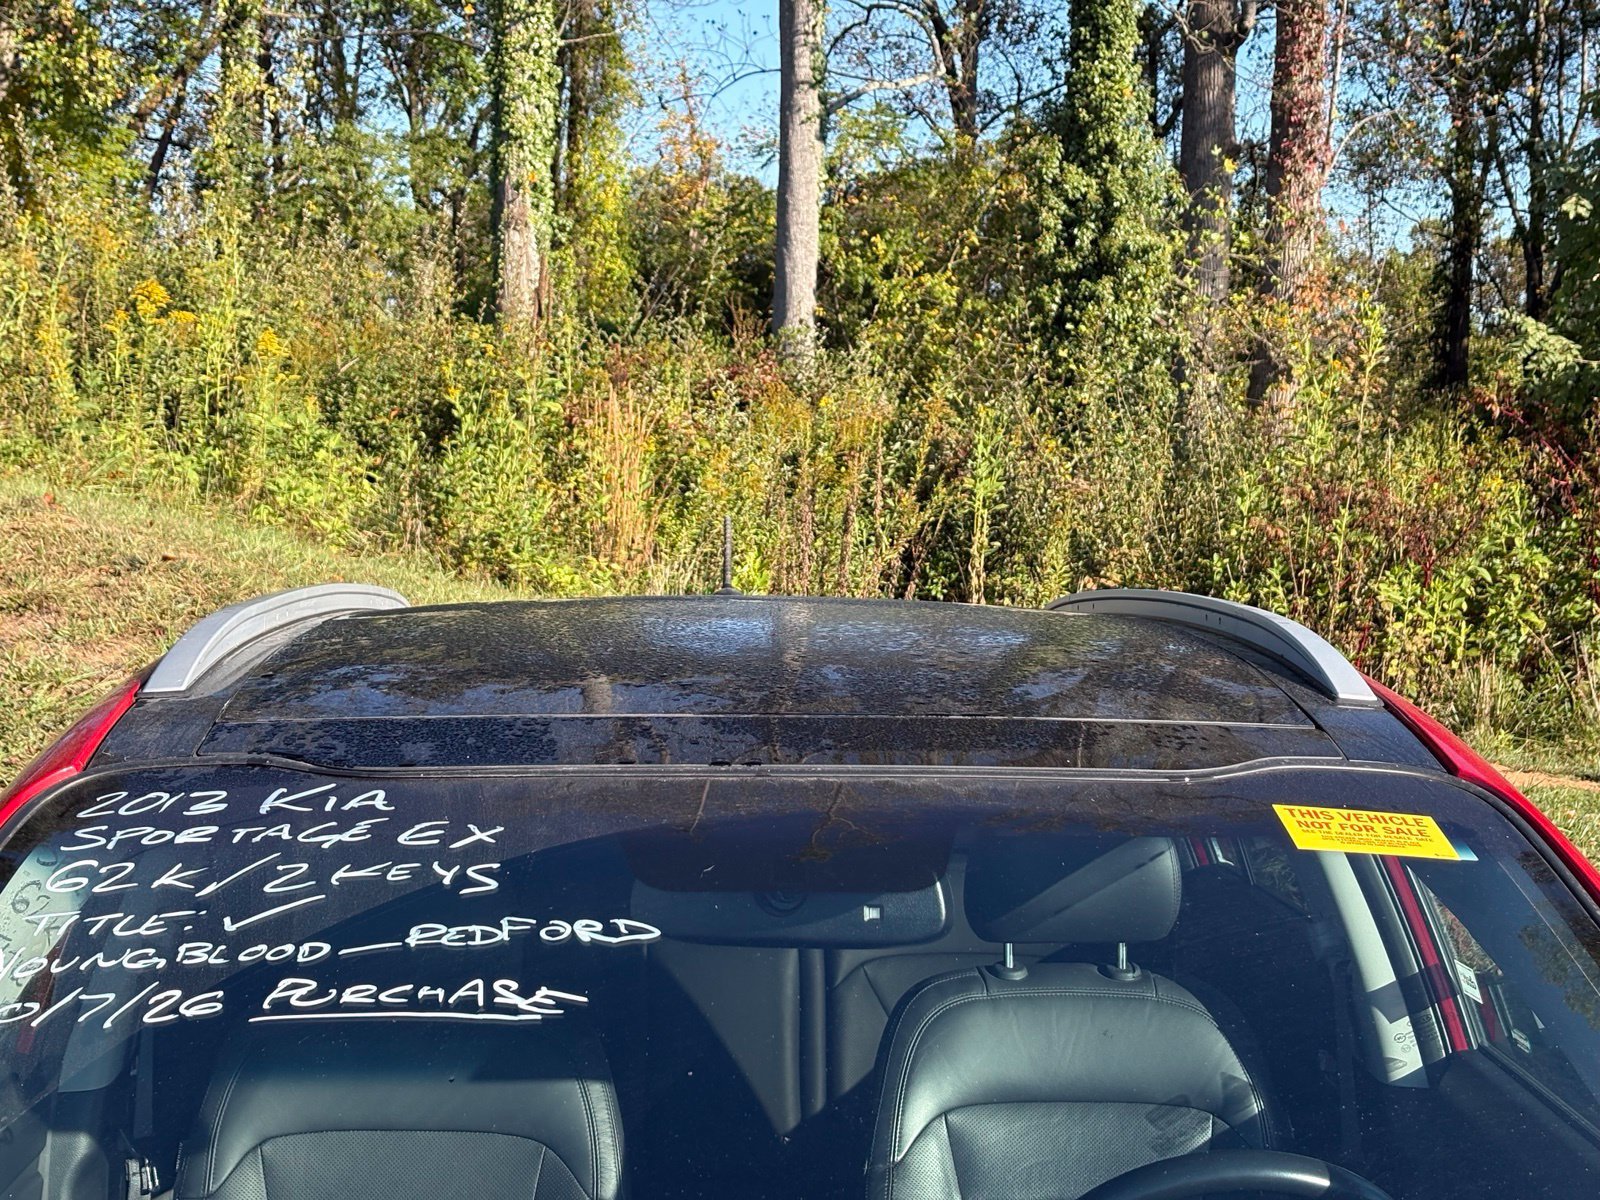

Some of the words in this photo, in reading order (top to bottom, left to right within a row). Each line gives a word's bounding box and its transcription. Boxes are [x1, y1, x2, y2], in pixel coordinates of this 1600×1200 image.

[76, 790, 228, 818] 2013
[259, 783, 395, 814] KIA
[60, 817, 389, 850] SPORTAGE
[397, 821, 504, 848] EX
[1284, 807, 1334, 821] THIS
[1337, 811, 1429, 828] VEHICLE
[1295, 819, 1332, 831] NOT
[1338, 822, 1377, 834] FOR
[1382, 826, 1431, 838] SALE
[330, 861, 501, 894] KEYS
[262, 978, 589, 1014] PURCHASE
